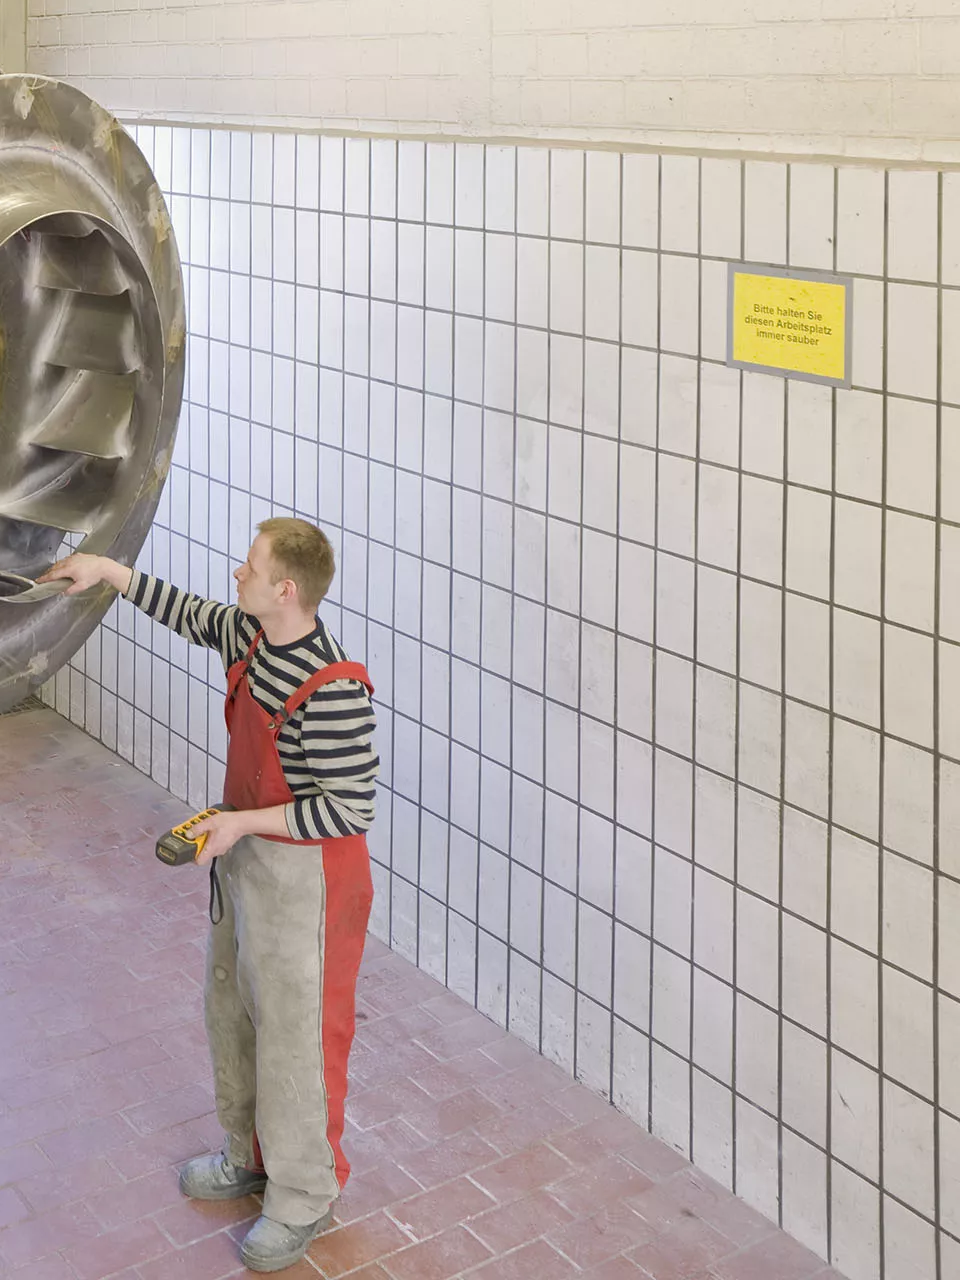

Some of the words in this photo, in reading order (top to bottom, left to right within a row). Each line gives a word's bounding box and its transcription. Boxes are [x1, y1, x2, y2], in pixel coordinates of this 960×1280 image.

[753, 303, 775, 315] Bitte
[777, 307, 805, 319] halten
[807, 310, 823, 322] Sie
[744, 315, 774, 328] diesen
[776, 319, 833, 336] Arbeitsplatz
[787, 333, 820, 346] sauber
